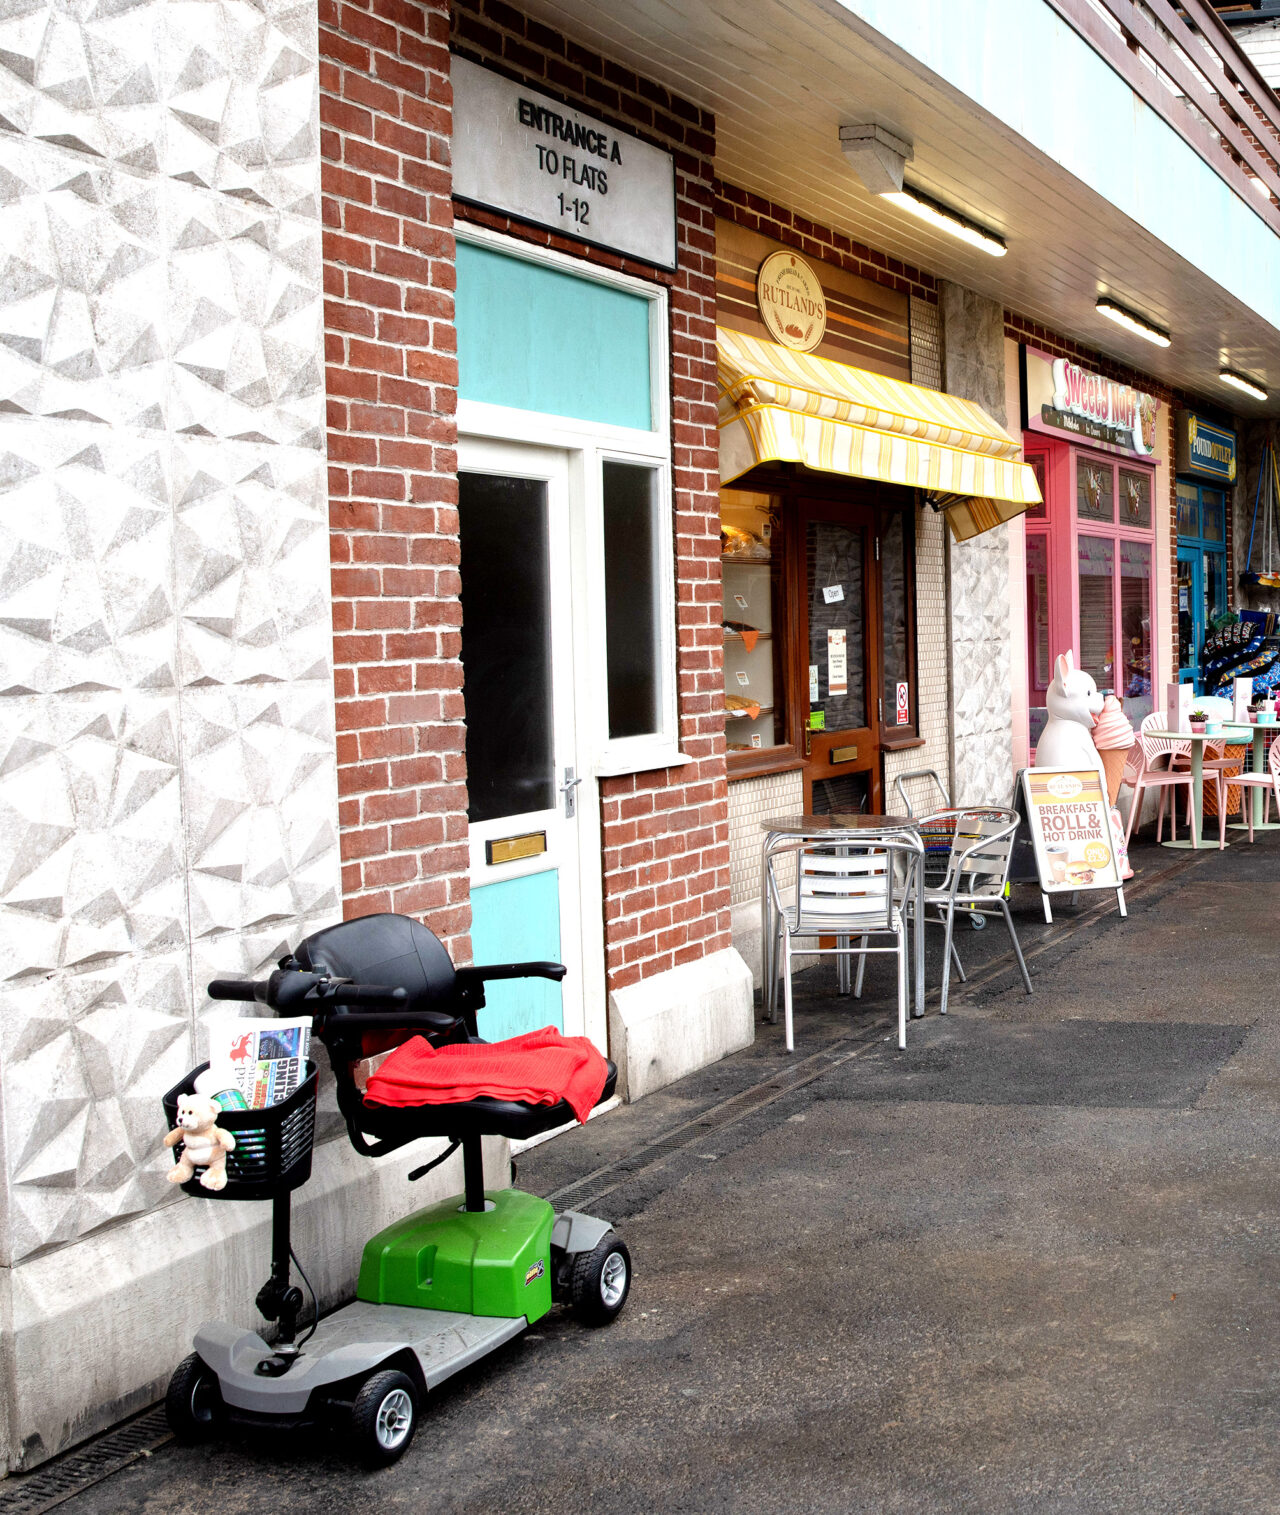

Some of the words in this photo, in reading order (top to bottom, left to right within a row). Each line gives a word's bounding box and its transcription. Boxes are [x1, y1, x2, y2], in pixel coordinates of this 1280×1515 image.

[518, 97, 608, 160] ENTRANCE
[610, 140, 622, 166] A
[535, 143, 559, 176] TO
[562, 155, 609, 196] FLATS
[556, 191, 590, 226] 1-12
[762, 282, 823, 321] RUTLAND'S
[828, 588, 840, 599] Open
[1038, 802, 1098, 816] BREAKFAST
[1040, 813, 1086, 832] ROLL
[1088, 813, 1101, 830] &
[1043, 831, 1066, 843] HOT
[1068, 828, 1103, 842] DRINK
